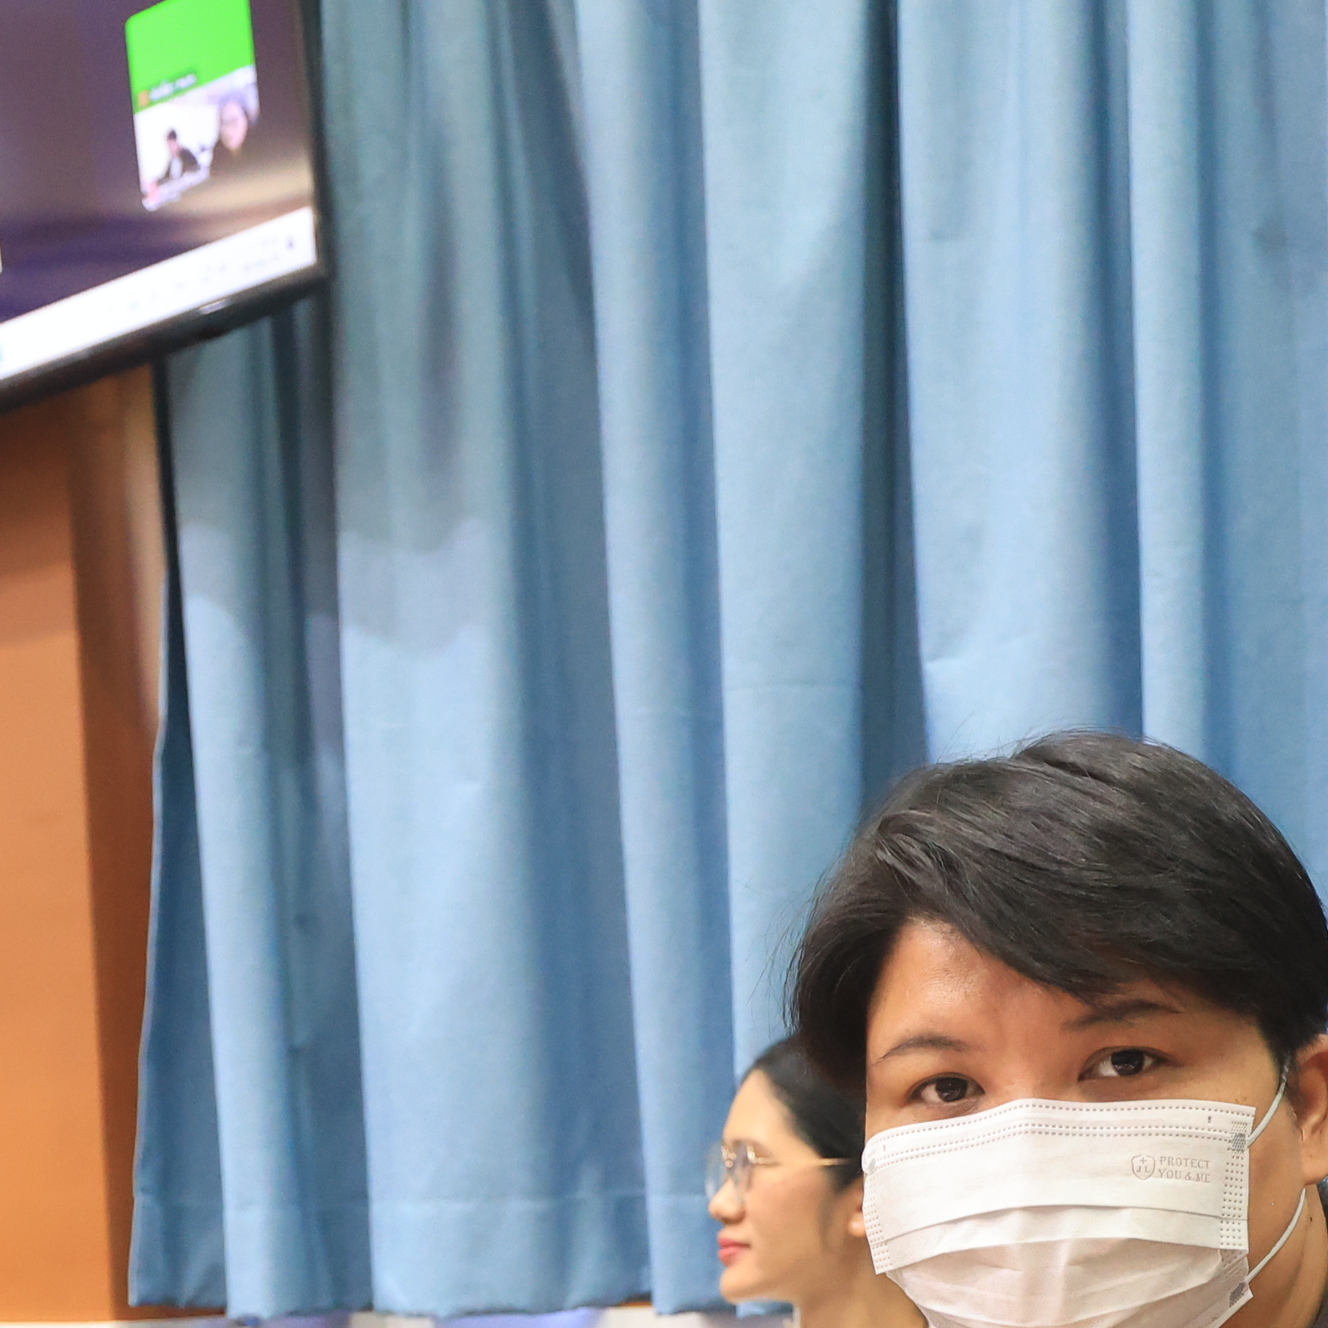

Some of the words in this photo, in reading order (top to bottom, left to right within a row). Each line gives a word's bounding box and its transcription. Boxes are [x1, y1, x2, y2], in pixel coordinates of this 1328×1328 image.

[1159, 1156, 1211, 1169] PROTECT
[1158, 1168, 1182, 1180] YOU
[1184, 1171, 1192, 1181] &
[1195, 1172, 1211, 1184] ME
